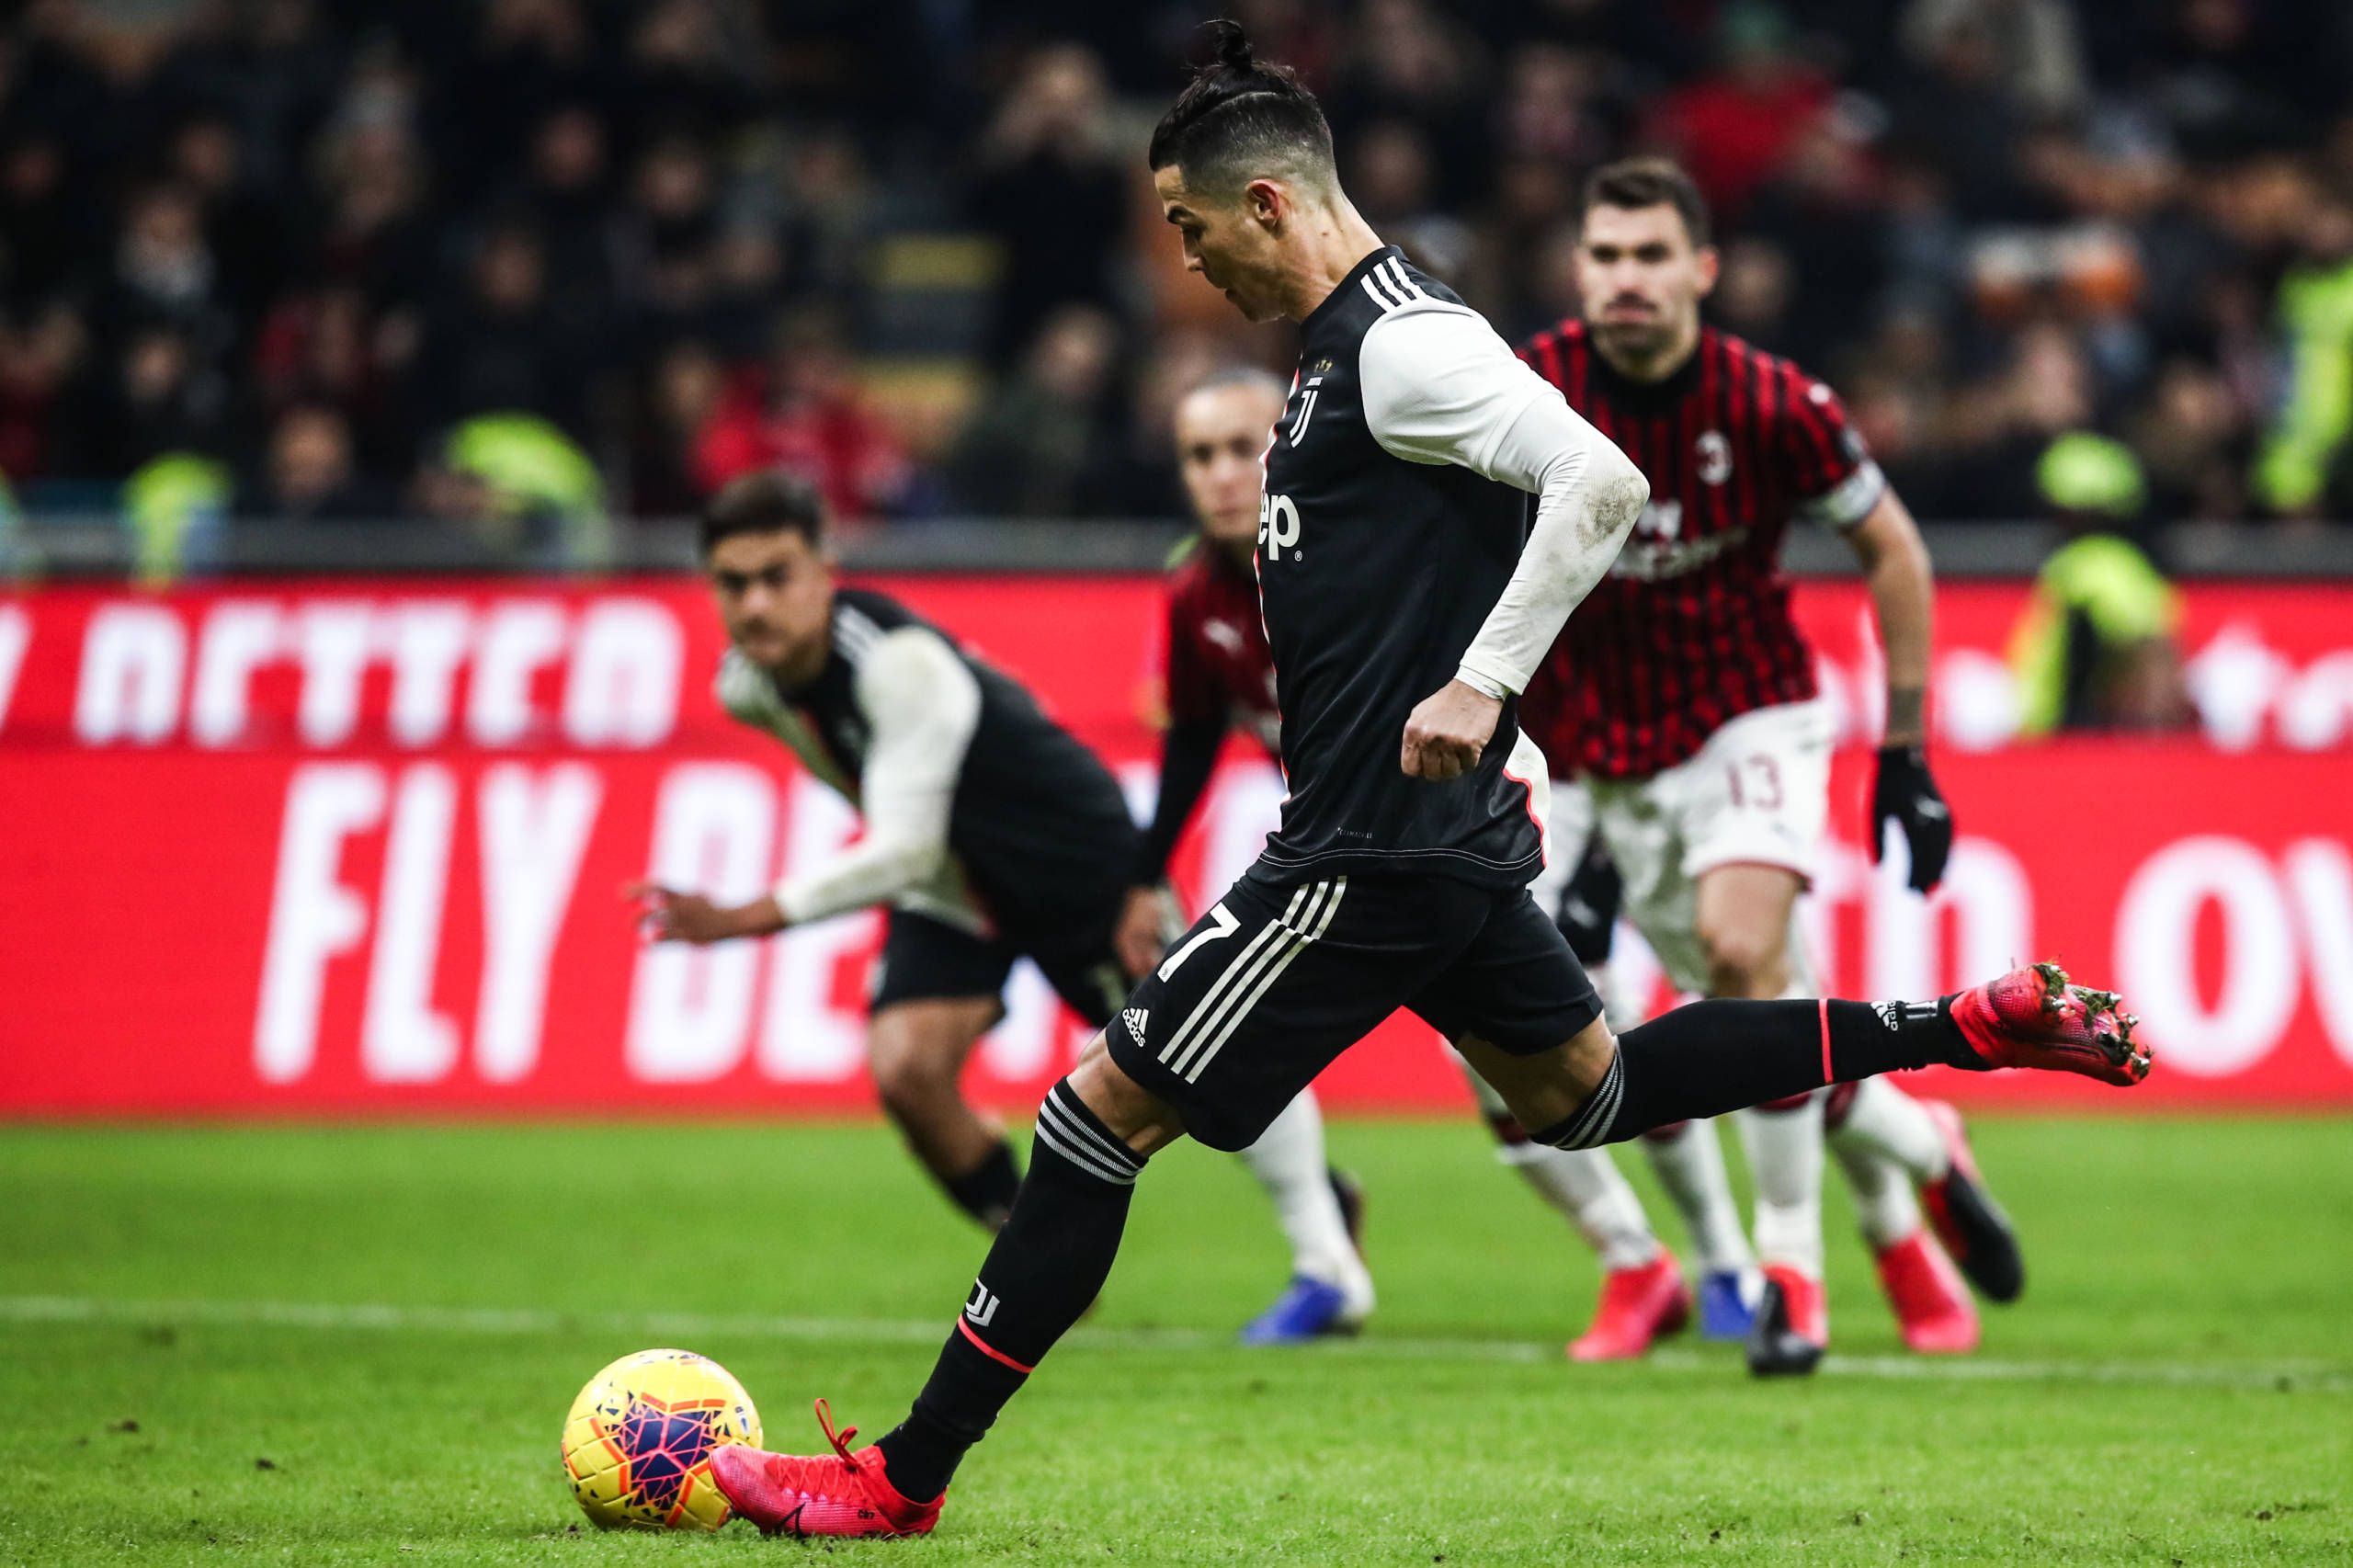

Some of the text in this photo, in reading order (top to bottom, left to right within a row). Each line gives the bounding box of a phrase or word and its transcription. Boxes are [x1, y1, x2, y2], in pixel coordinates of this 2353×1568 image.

[1725, 754, 1785, 811] 13
[255, 765, 602, 1082] FLY
[1157, 902, 1241, 983] 7
[1122, 1008, 1146, 1048] adidas
